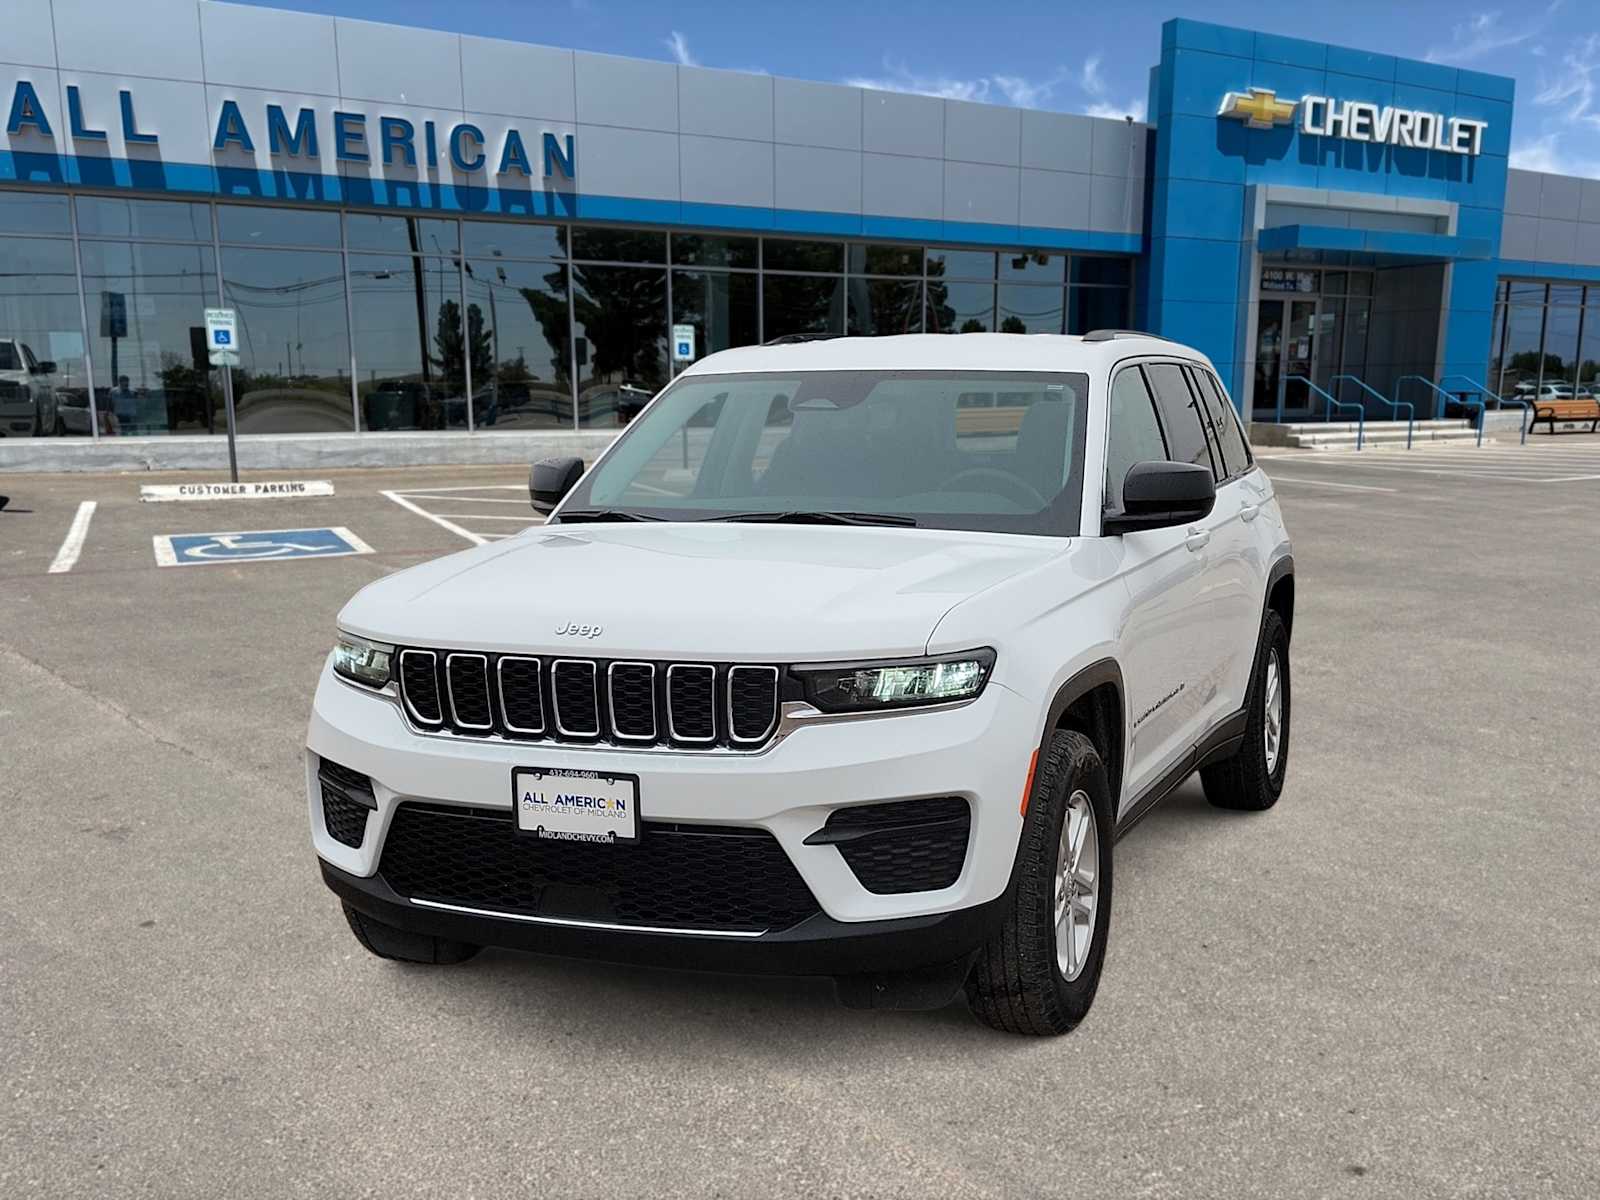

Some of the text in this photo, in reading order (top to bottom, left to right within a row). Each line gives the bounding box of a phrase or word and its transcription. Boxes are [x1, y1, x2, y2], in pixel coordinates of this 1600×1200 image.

[7, 81, 576, 180] ALL AMERICAN
[1301, 94, 1488, 155] CHEVROLET
[179, 483, 306, 495] CUSTOMER PARKING
[555, 620, 603, 639] Jeep
[523, 791, 548, 804] ALL
[523, 803, 626, 819] CHEVROLET OF MIDLAND
[539, 830, 615, 844] MIDLANDCHEVY.COM
